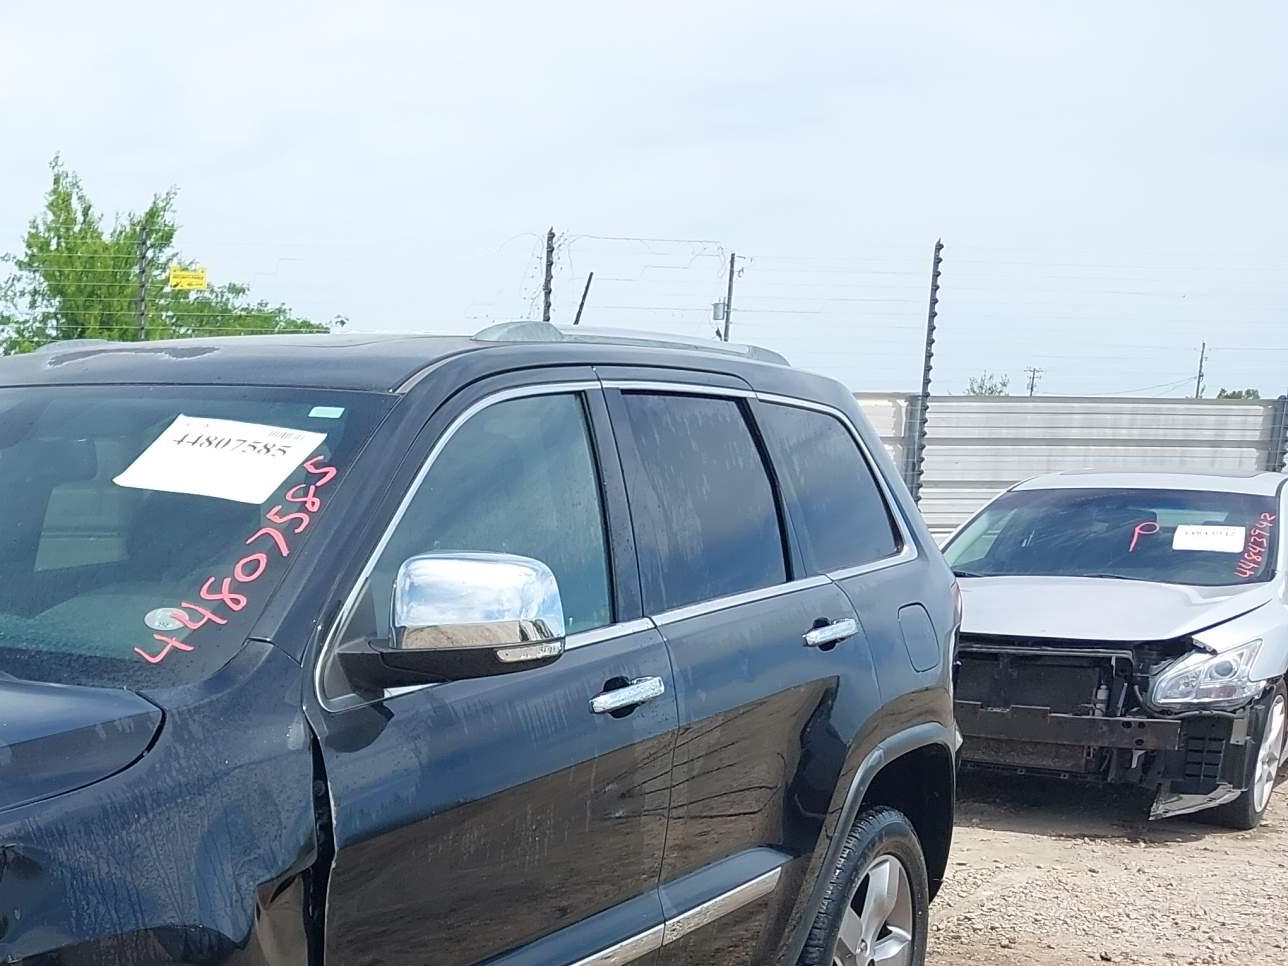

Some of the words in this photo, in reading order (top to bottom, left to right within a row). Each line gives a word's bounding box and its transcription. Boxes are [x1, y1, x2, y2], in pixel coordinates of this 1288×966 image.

[172, 433, 292, 457] 44807585
[134, 455, 338, 664] 44807585
[1233, 512, 1276, 578] 44843942
